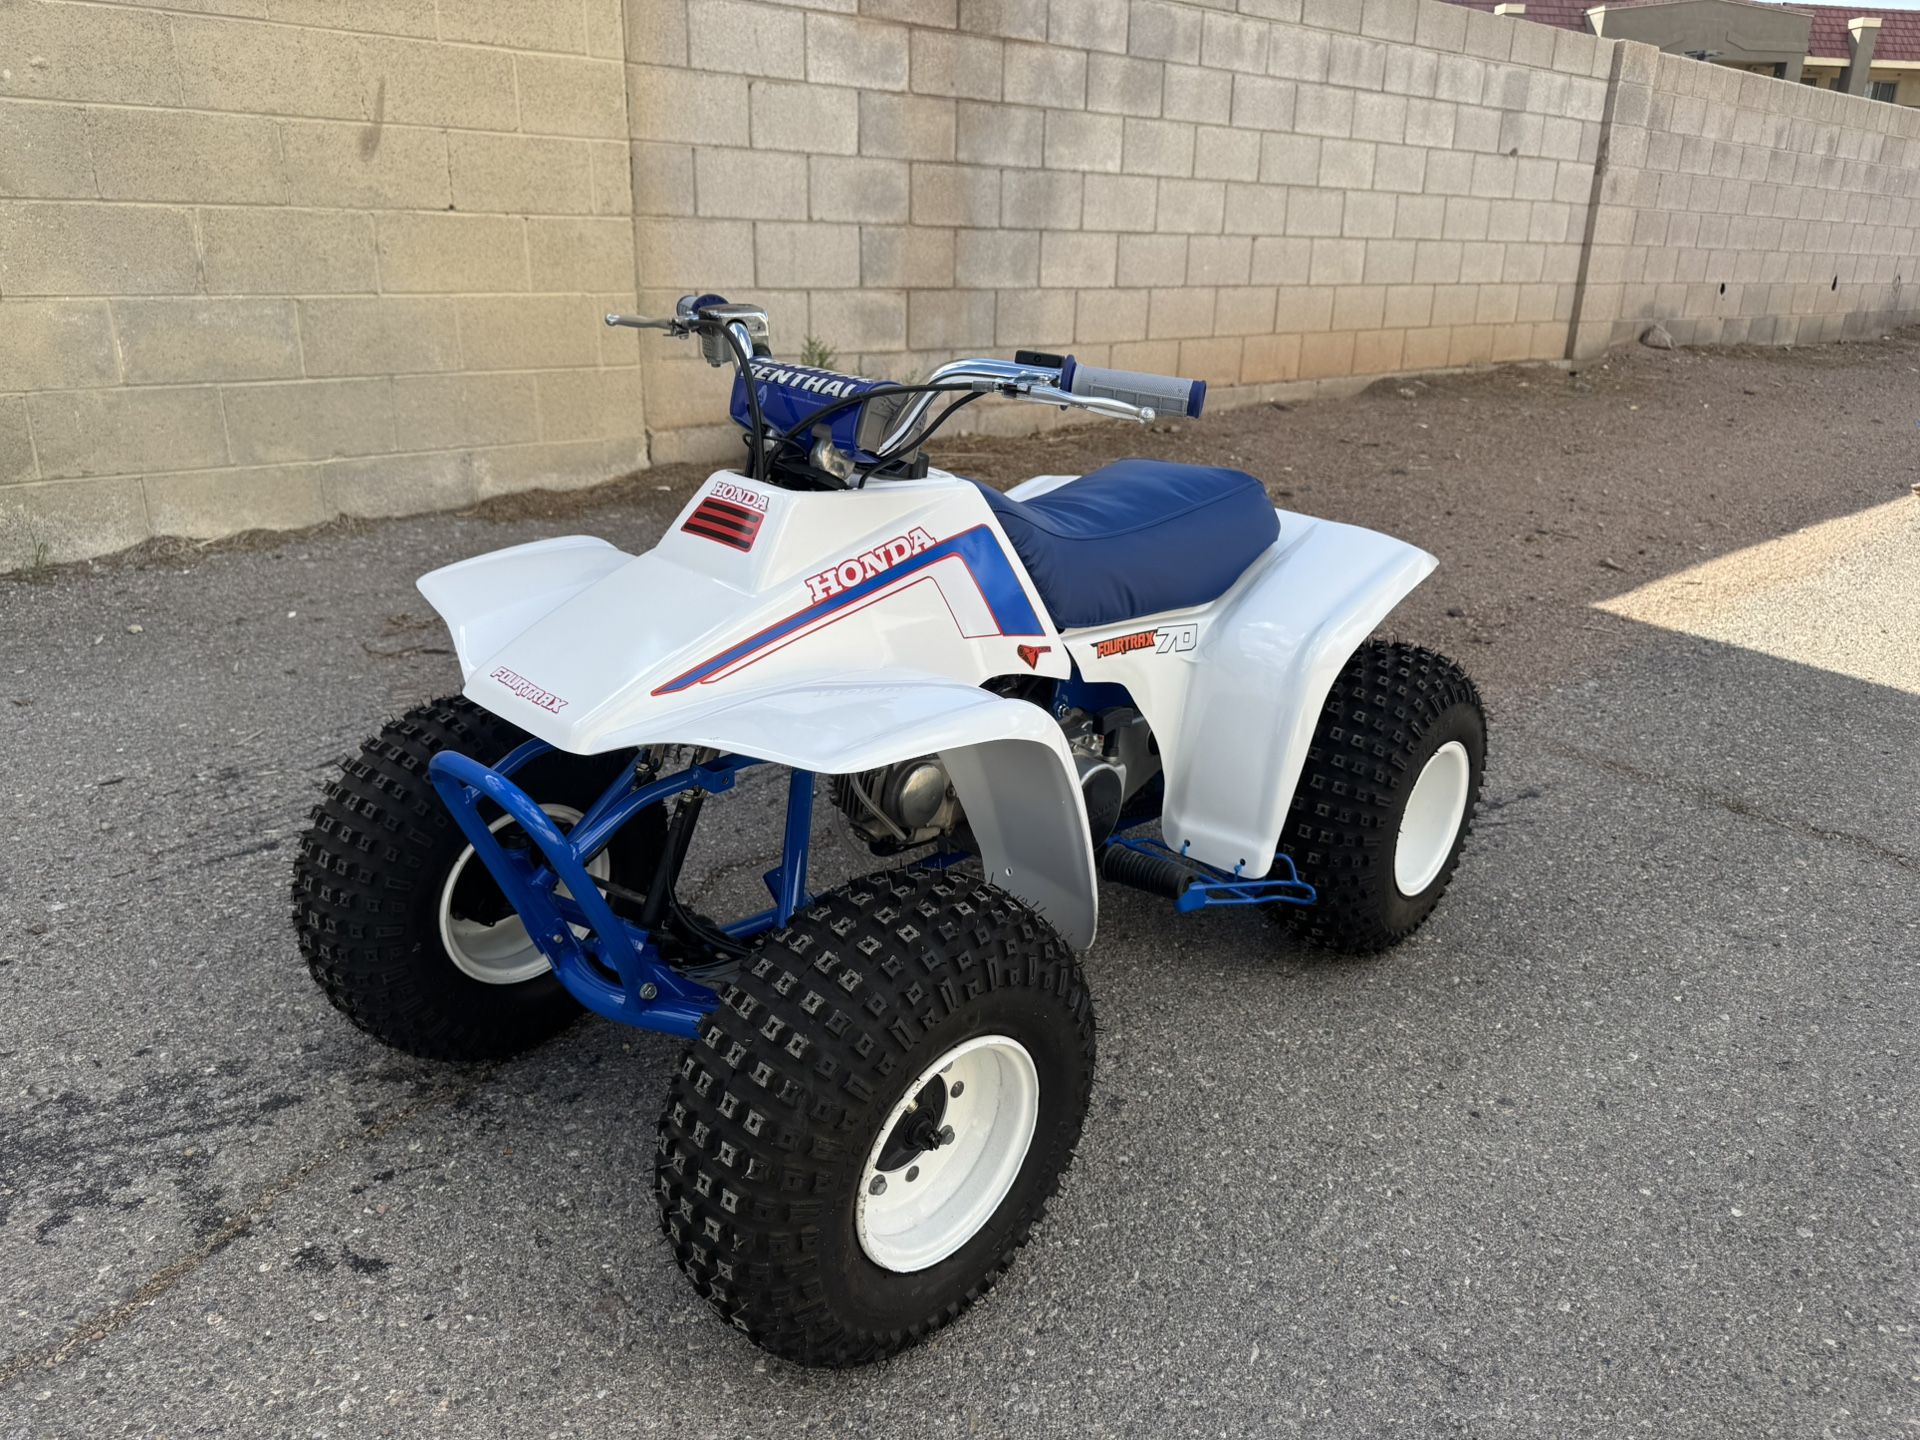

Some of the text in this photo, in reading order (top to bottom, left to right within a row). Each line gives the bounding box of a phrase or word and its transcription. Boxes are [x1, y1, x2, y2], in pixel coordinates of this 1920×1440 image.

[711, 481, 769, 512] HONDA
[805, 526, 938, 604] HONDA
[1095, 623, 1198, 659] FOURTRAX 70
[490, 666, 569, 714] FOURTRAX
